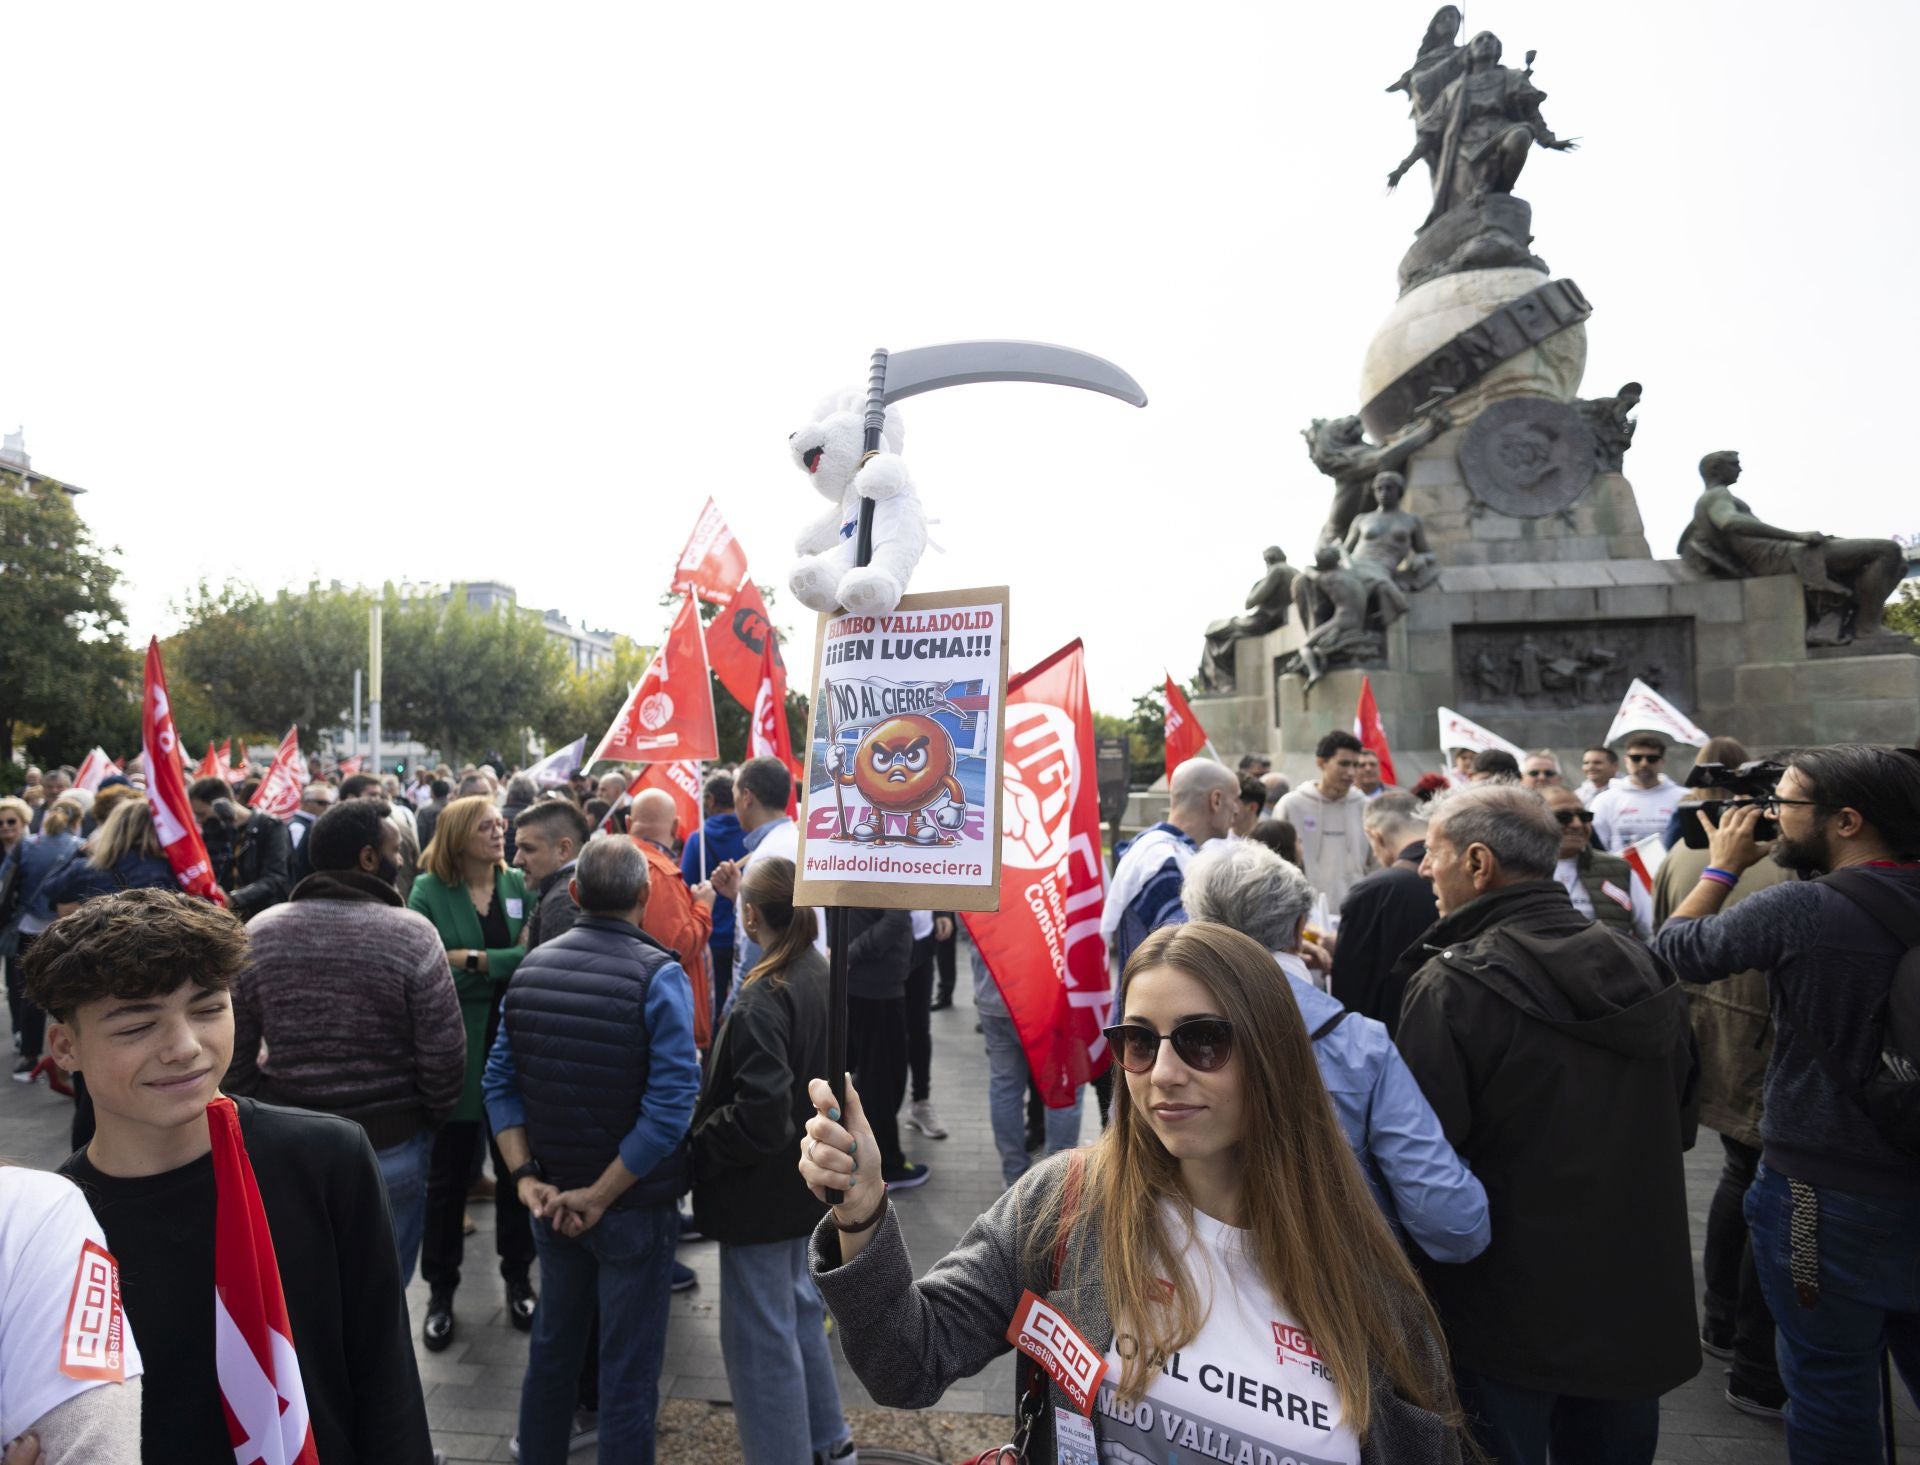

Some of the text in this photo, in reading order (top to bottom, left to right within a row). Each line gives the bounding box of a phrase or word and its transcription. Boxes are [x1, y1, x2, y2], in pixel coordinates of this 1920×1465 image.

[828, 611, 994, 640] BIMBO VALLADOLID
[825, 635, 992, 667] ¡¡¡EN LUCHA!!!
[834, 684, 936, 722] NO AL CIERRE
[806, 855, 983, 877] #valladolidnosecierra
[1024, 882, 1066, 984] Construcc
[77, 1262, 107, 1358] CCOO
[112, 1300, 122, 1313] y
[106, 1315, 122, 1370] Castilla
[1033, 1311, 1092, 1382] CCOO
[1018, 1333, 1057, 1371] Castilla
[1055, 1369, 1064, 1382] y
[1063, 1375, 1086, 1408] León
[1115, 1333, 1139, 1360] O
[1198, 1363, 1331, 1432] CIERRE
[1312, 1362, 1336, 1383] FIC
[1097, 1386, 1154, 1432] MBO
